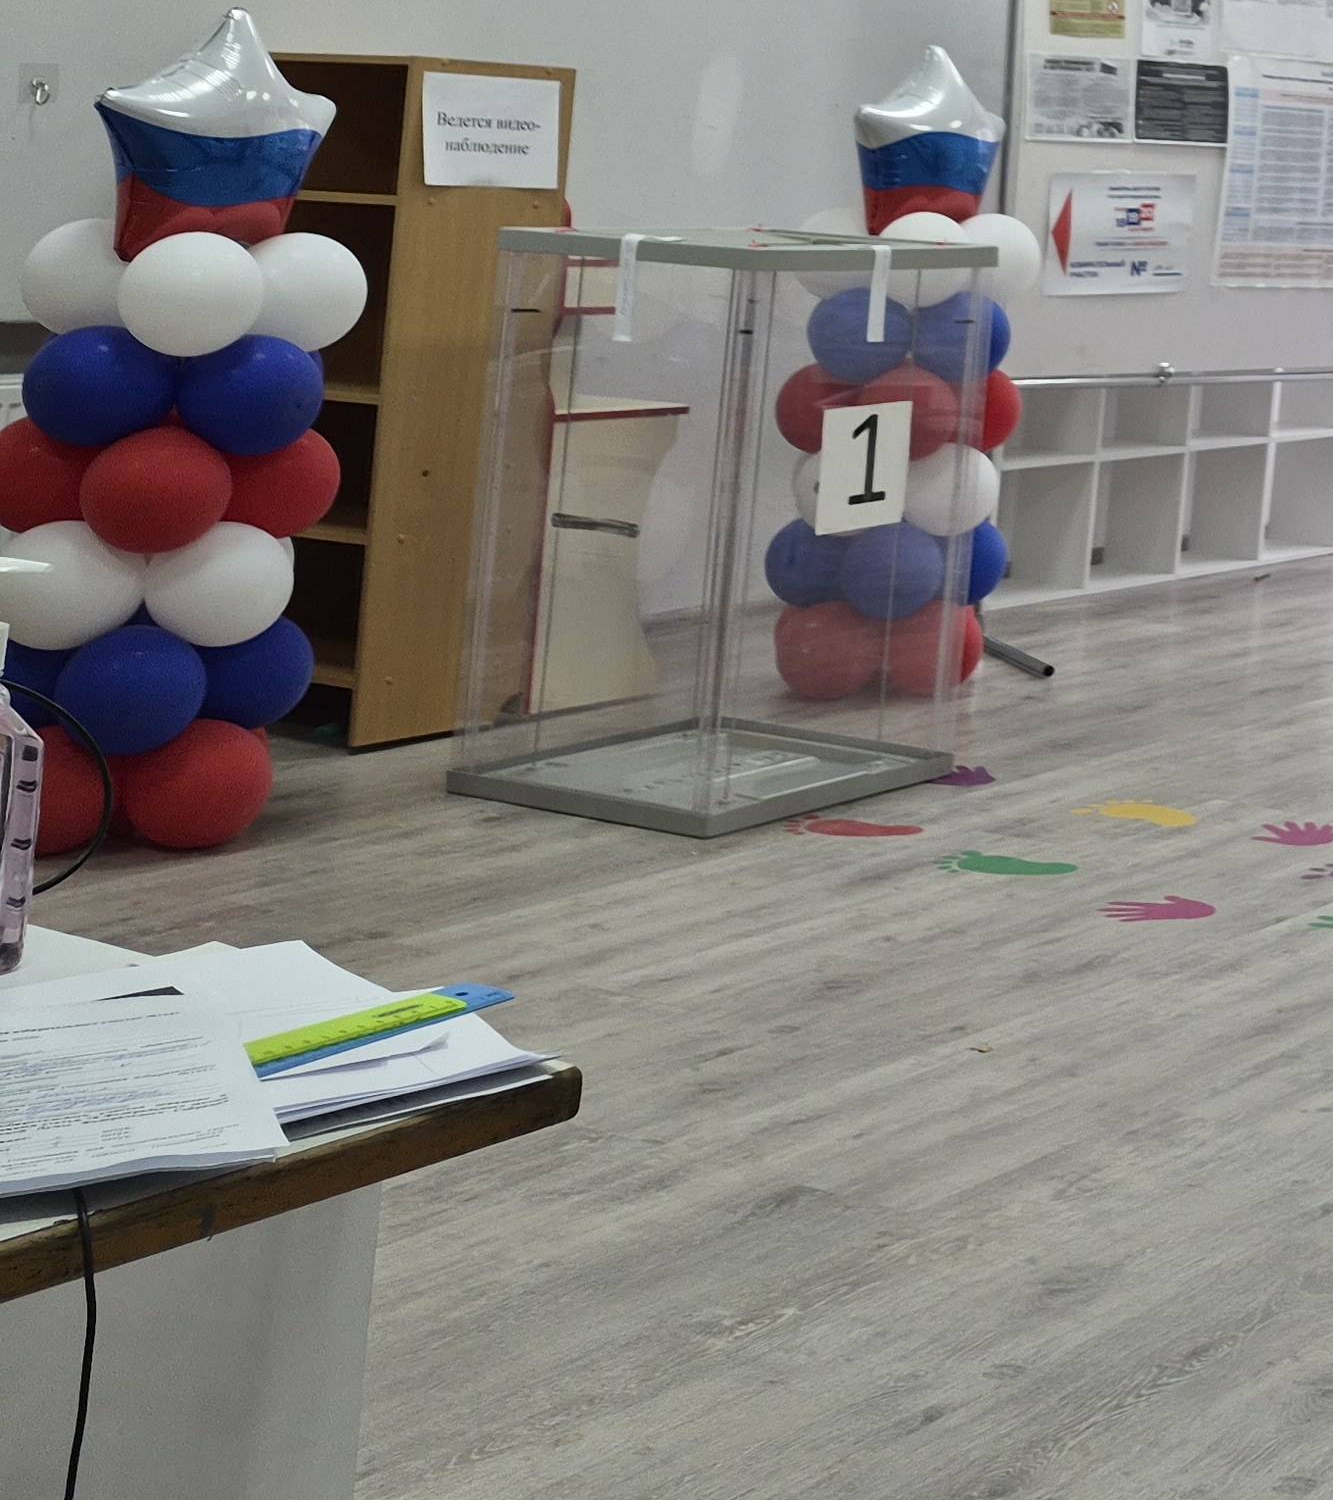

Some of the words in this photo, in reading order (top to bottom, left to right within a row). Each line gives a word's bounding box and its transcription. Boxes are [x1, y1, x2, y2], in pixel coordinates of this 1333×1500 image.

[437, 111, 492, 129] Ведется
[496, 117, 542, 132] видео-
[445, 137, 530, 156] наблюдение
[848, 414, 886, 506] 1
